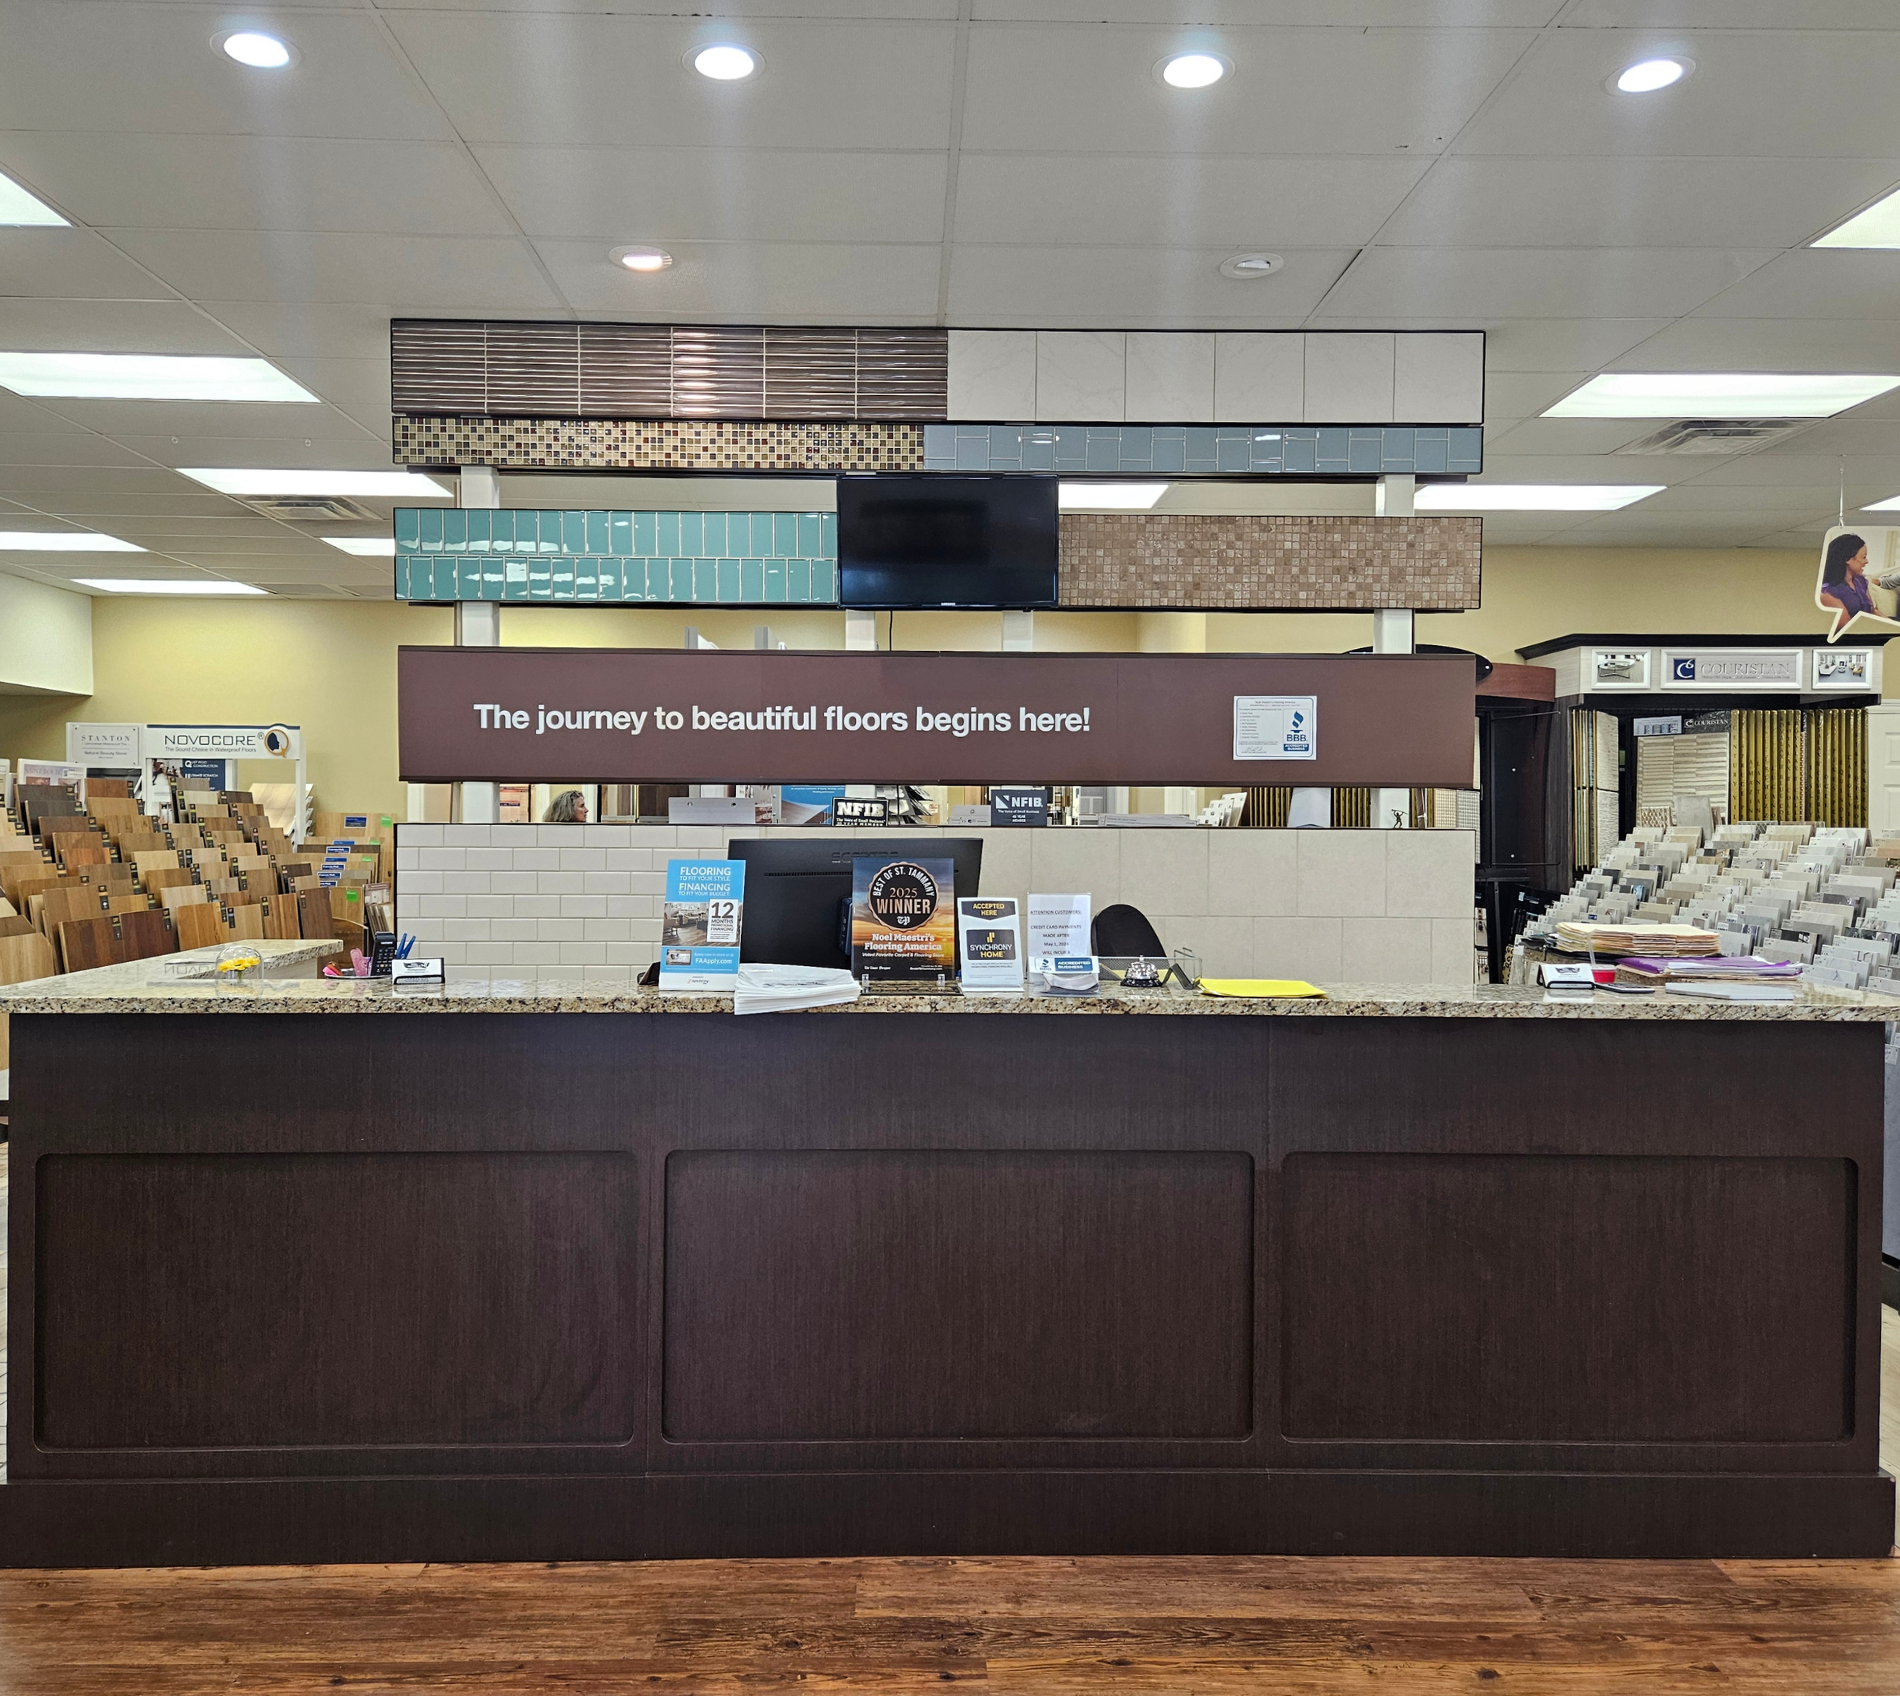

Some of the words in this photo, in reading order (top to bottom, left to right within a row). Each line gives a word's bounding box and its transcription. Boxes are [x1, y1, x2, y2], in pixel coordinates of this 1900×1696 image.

[1701, 663, 1790, 676] COURISTAN
[474, 704, 529, 730] The
[536, 704, 647, 735] journey
[654, 708, 684, 731] to
[691, 705, 817, 731] beautiful
[823, 705, 908, 732] floors
[916, 706, 1012, 737] begins
[1018, 706, 1091, 733] here!
[1286, 734, 1307, 742] BBB
[1012, 797, 1042, 807] NFIB
[837, 802, 884, 817] NFIB
[680, 866, 731, 876] FLOORING
[872, 876, 885, 897] BEST
[883, 869, 894, 881] OF
[895, 866, 906, 876] ST.
[908, 867, 935, 897] TAMMANY
[679, 883, 731, 892] FINANCING
[889, 887, 918, 898] 2025
[711, 902, 734, 919] 12
[876, 898, 931, 914] WINNER
[872, 933, 893, 941] Noel
[894, 933, 935, 942] Maestri's
[864, 942, 903, 952] Flooring
[904, 942, 942, 951] America
[970, 943, 1012, 951] SYNCHRONY
[695, 957, 733, 965] FAApply.com
